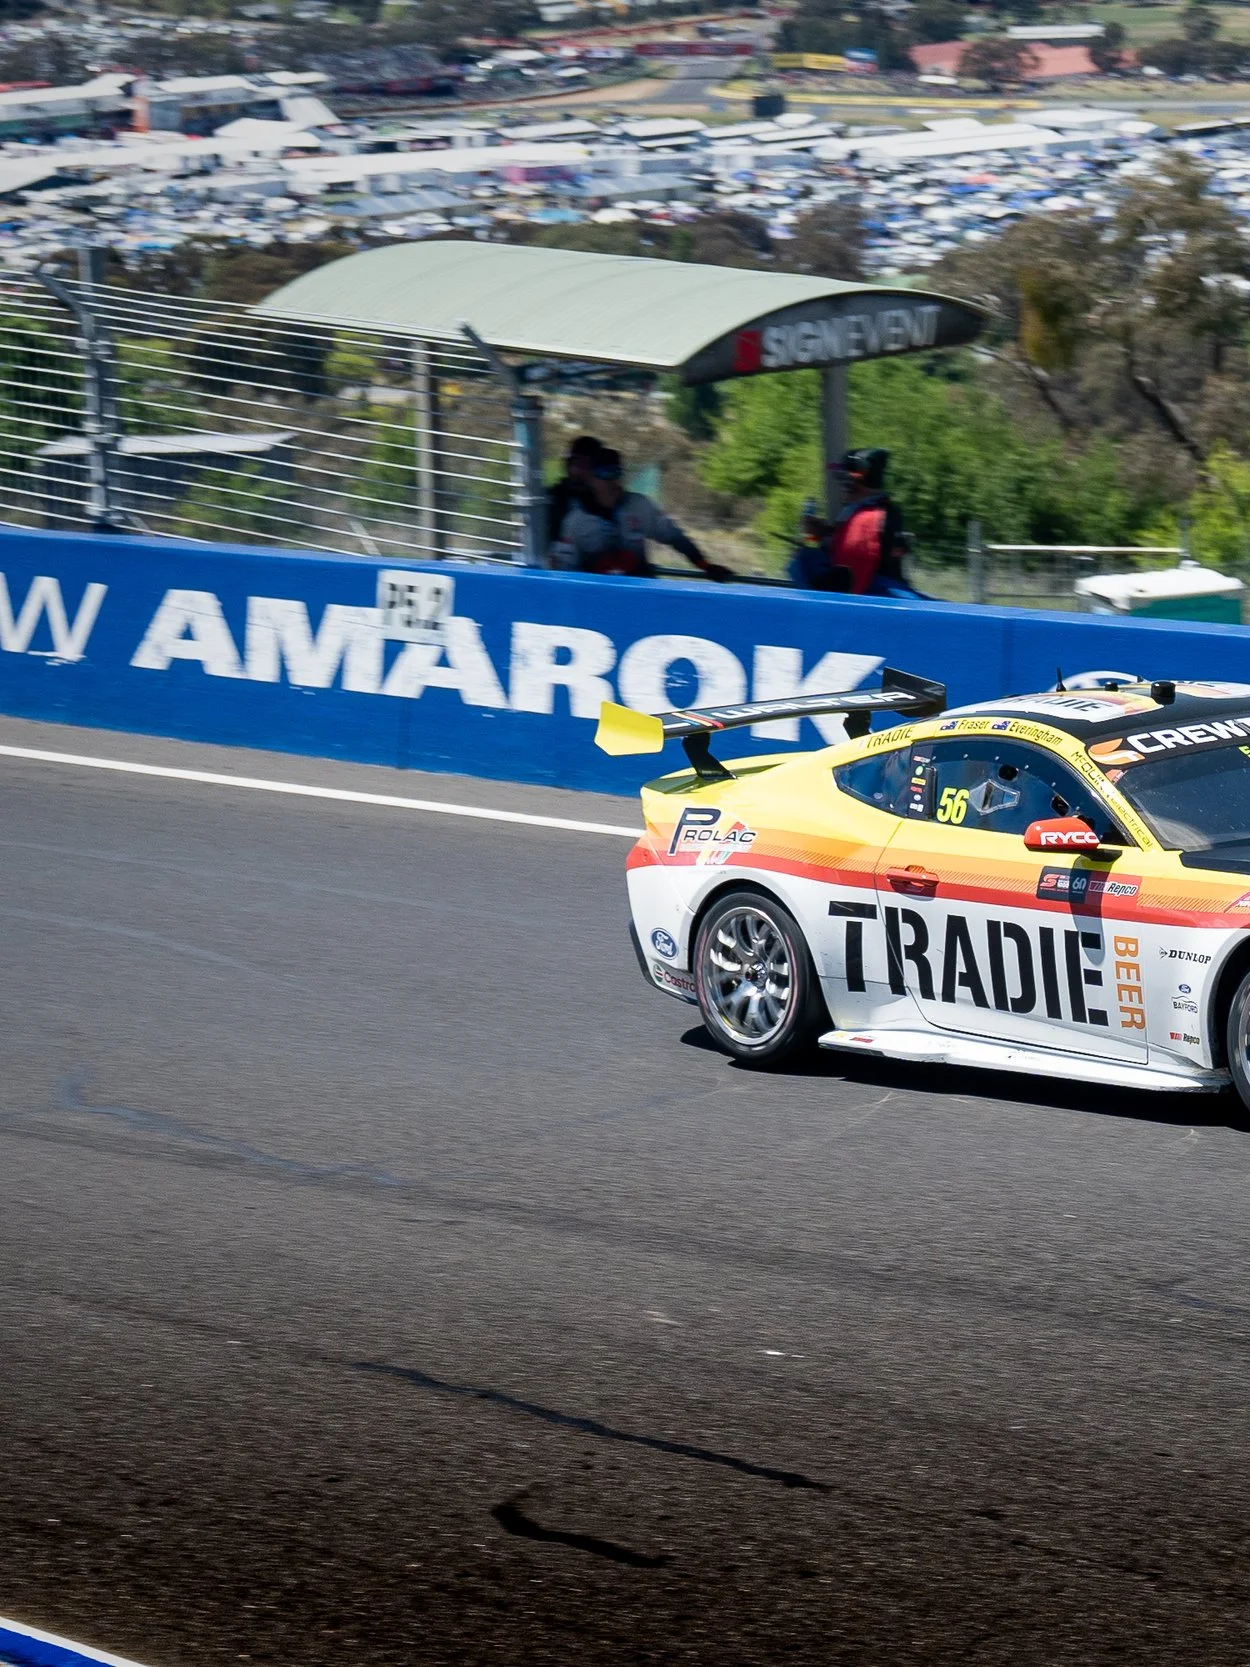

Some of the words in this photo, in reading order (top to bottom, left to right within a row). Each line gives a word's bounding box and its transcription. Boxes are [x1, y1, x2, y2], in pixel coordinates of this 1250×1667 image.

[129, 589, 887, 745] AMAROK
[866, 726, 913, 748] TRADIE
[957, 719, 989, 731] Fraser
[1009, 721, 1064, 746] Everingham
[936, 787, 970, 825] 56
[669, 807, 757, 854] PROLAC
[1107, 881, 1137, 896] Repco
[828, 899, 1110, 1027] TRADIE
[1168, 949, 1212, 965] DUNLOP
[664, 971, 698, 993] Castro
[1112, 935, 1147, 1031] BEER
